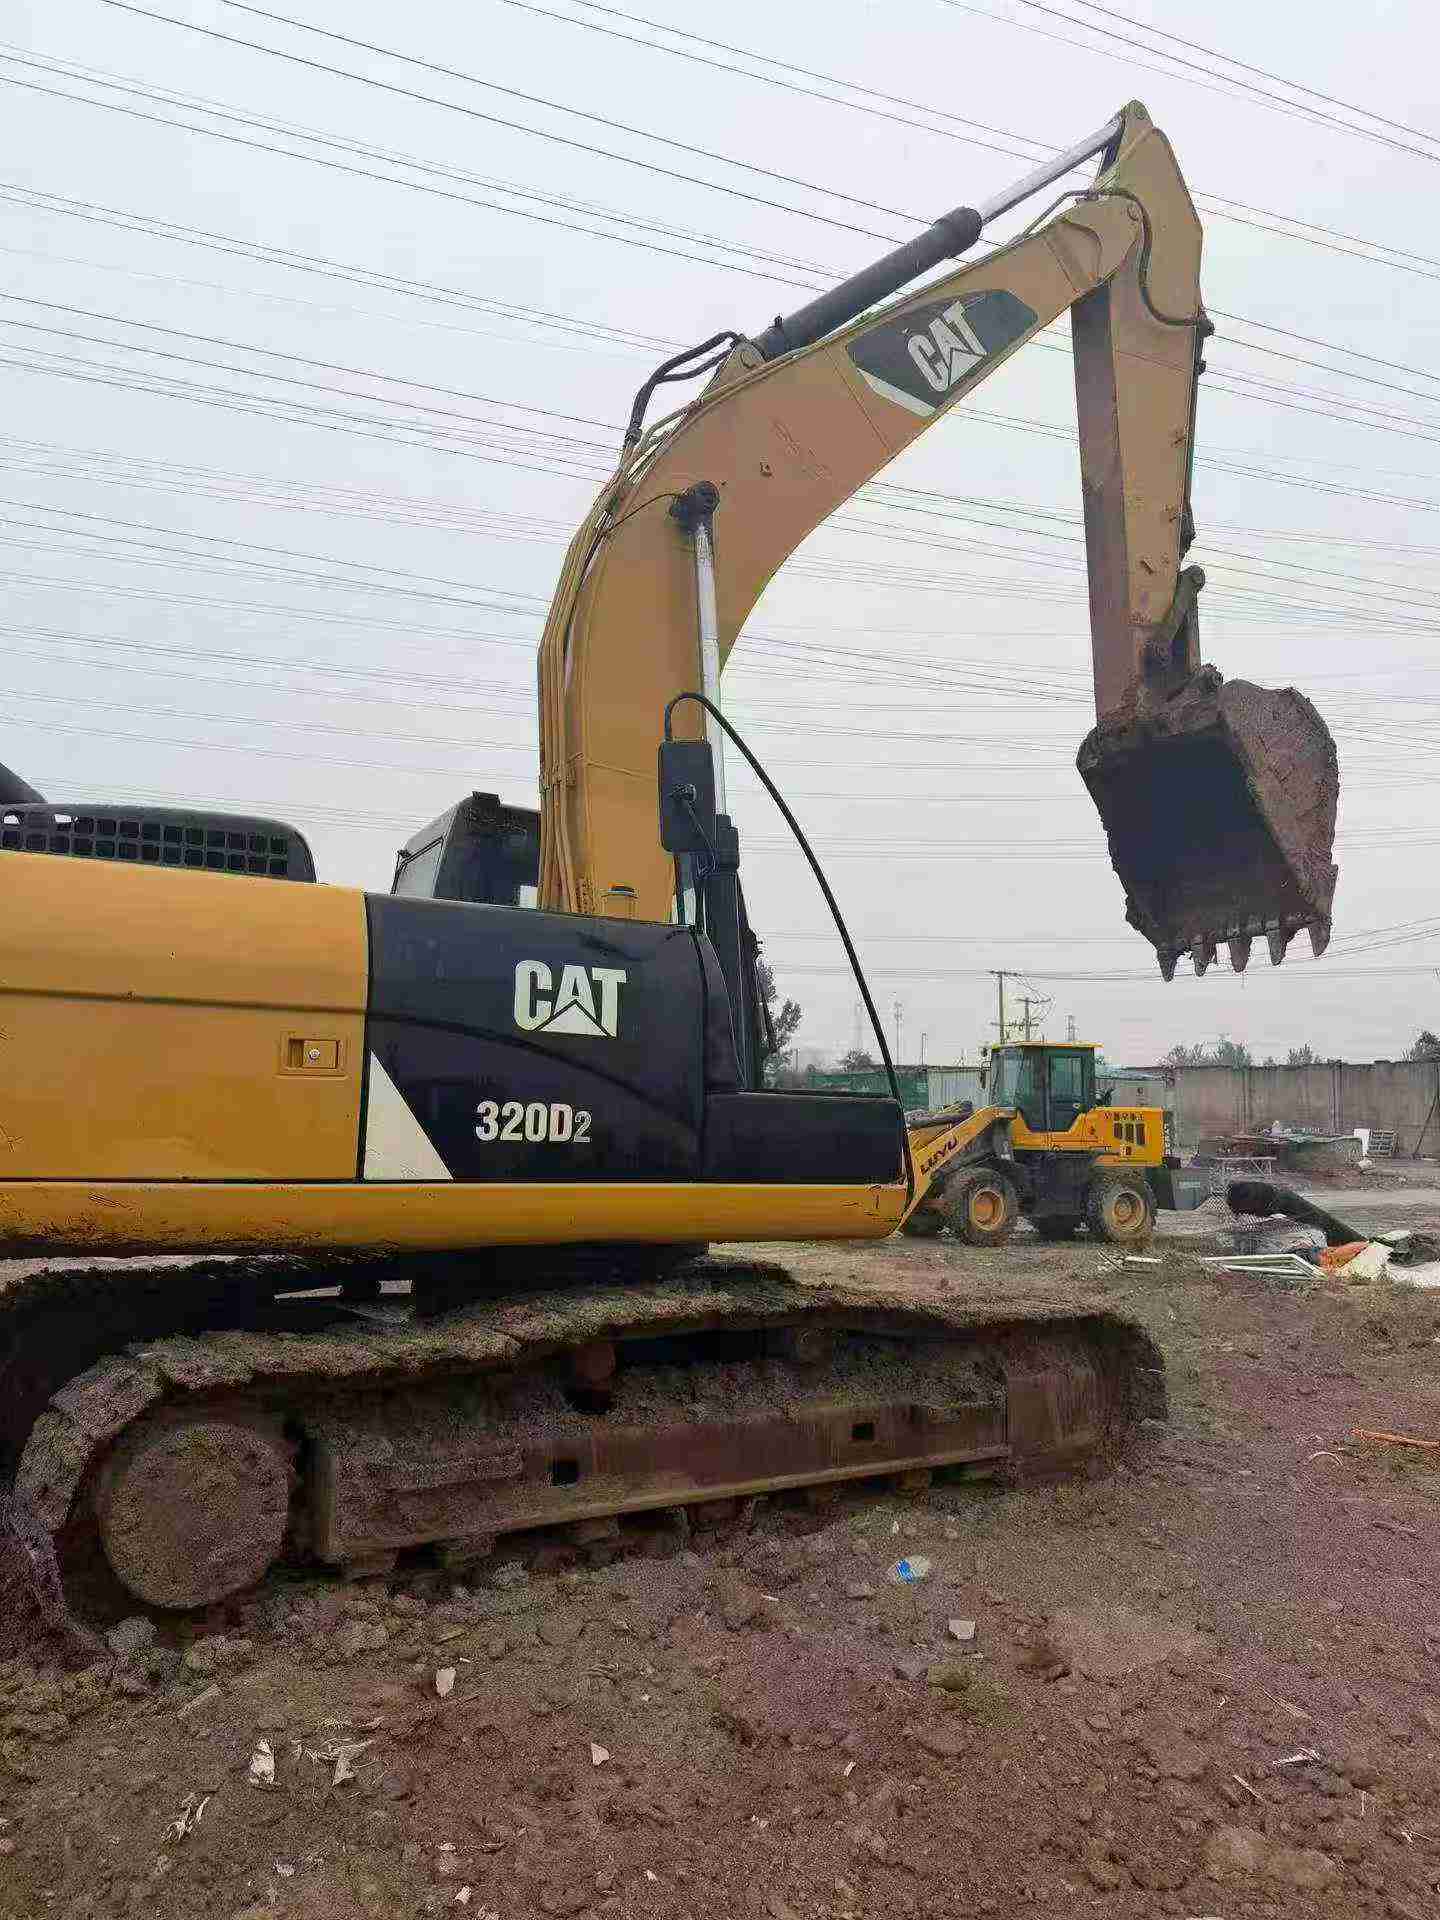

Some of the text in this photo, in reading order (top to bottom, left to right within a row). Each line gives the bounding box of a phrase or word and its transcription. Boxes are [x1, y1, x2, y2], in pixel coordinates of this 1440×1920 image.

[907, 300, 988, 392] CAT
[514, 959, 627, 1038] CAT
[475, 1100, 592, 1143] 320D2
